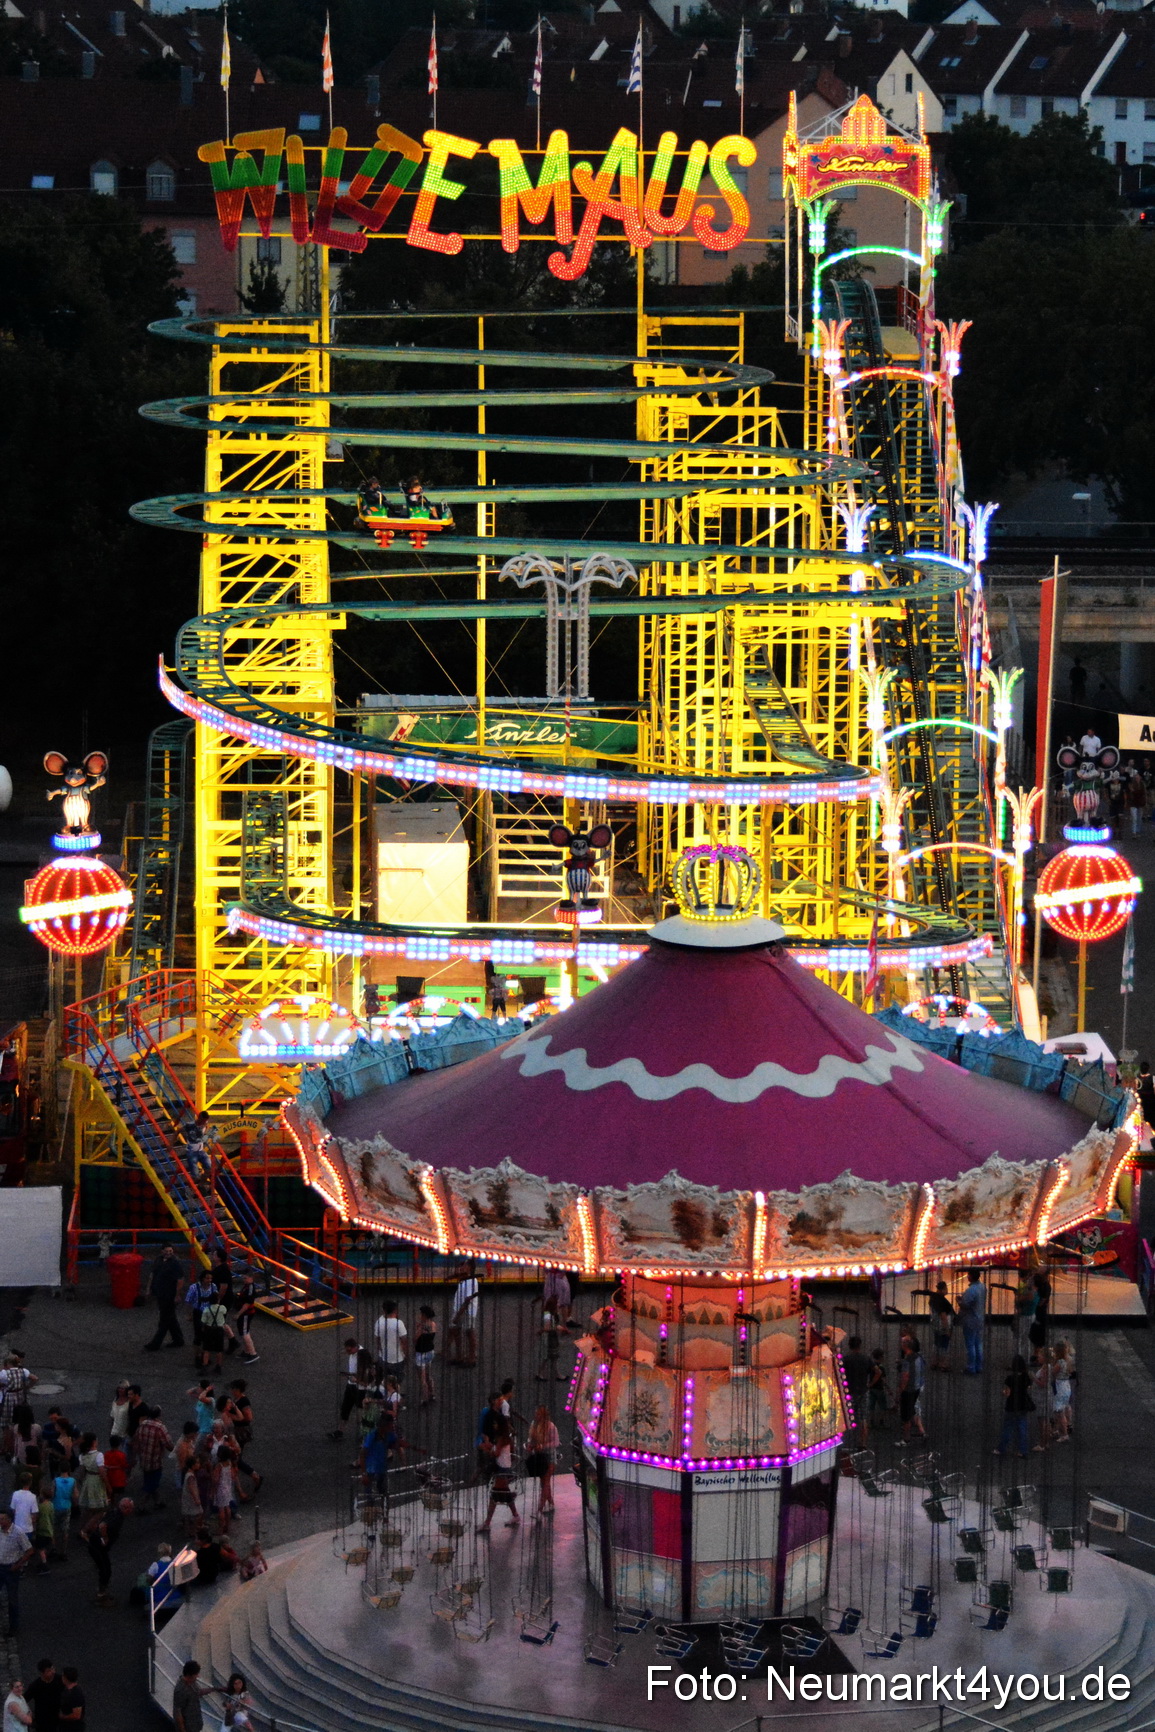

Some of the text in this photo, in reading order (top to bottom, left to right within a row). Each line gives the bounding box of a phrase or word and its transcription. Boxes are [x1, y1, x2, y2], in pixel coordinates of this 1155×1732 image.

[198, 123, 757, 281] WILDE MAUS
[223, 1120, 258, 1134] AUSGANG
